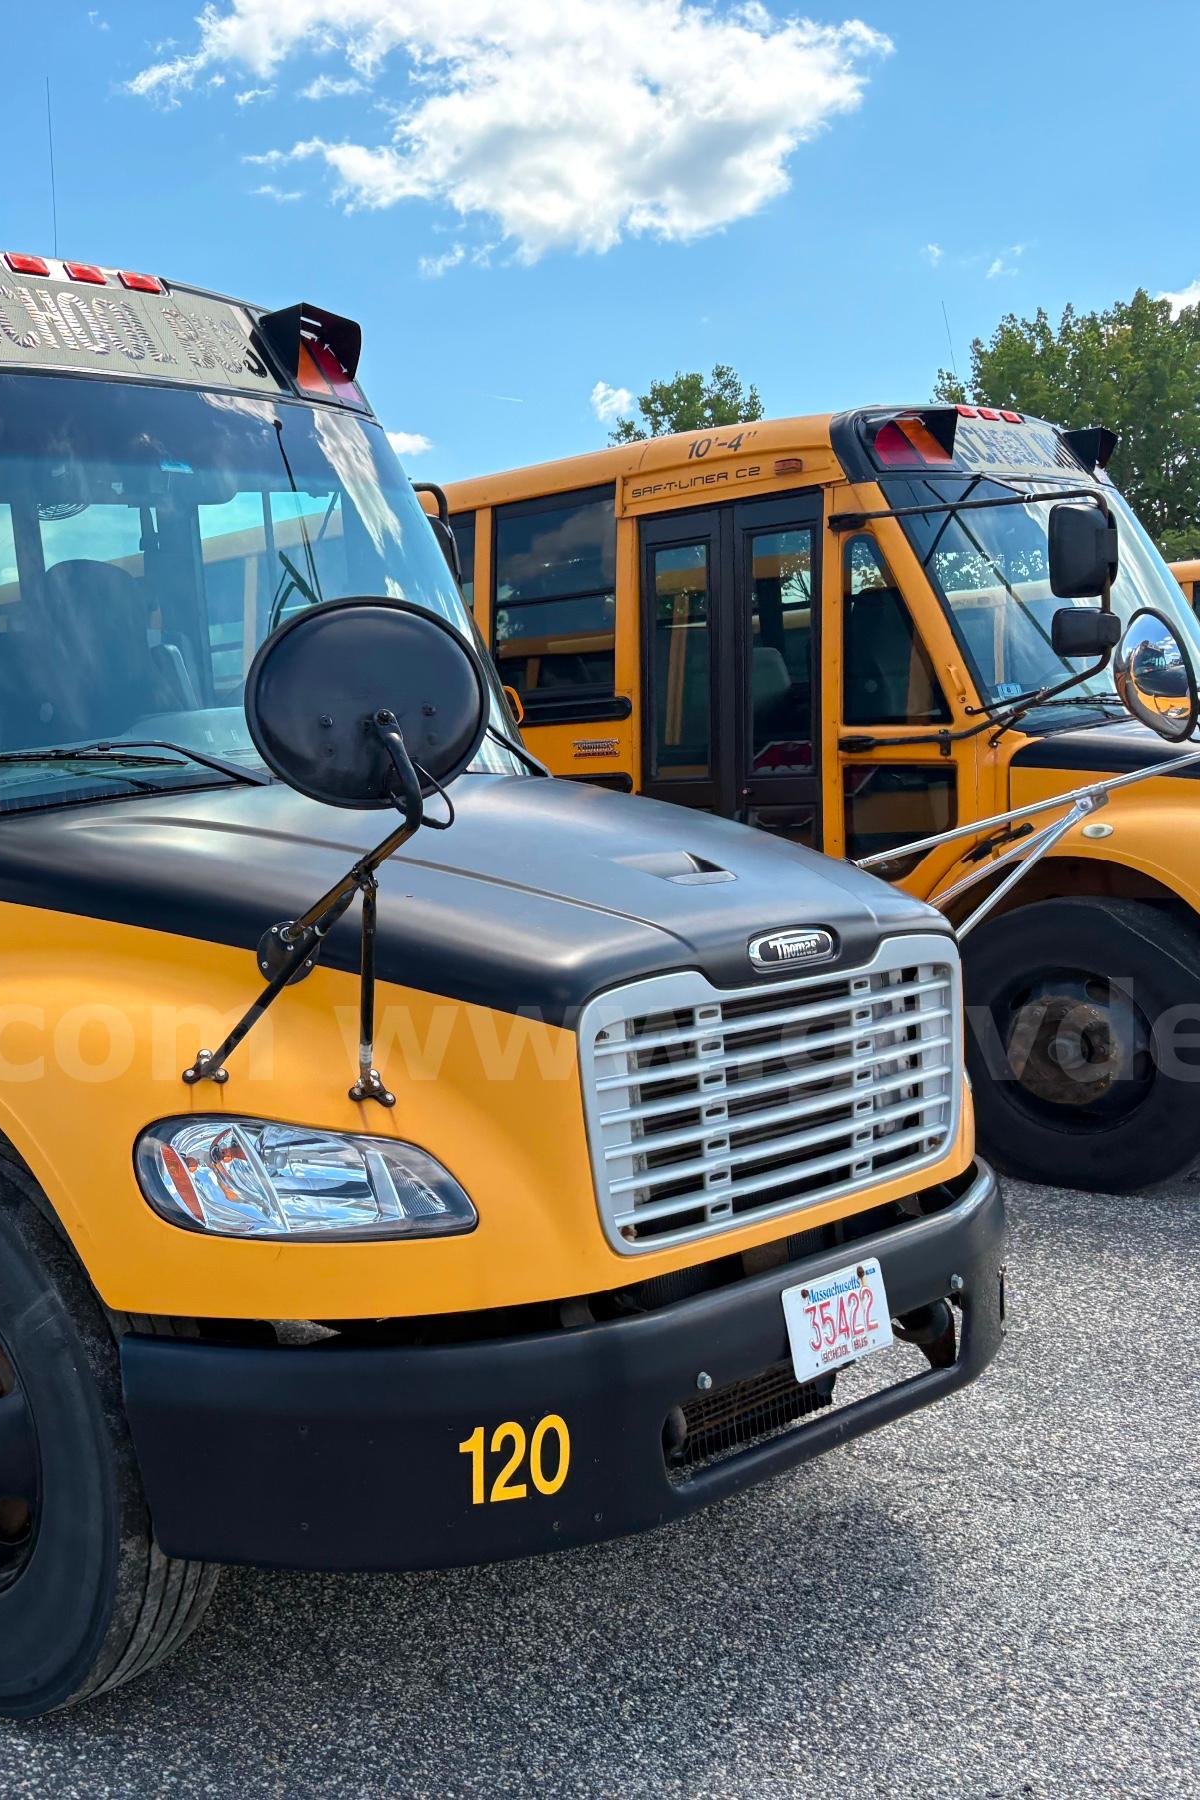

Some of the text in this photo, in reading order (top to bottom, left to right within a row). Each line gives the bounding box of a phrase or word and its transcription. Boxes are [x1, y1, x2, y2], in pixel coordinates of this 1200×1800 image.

[735, 465, 761, 479] C2
[768, 933, 821, 961] Thomas
[807, 1275, 861, 1305] Massachusetts
[804, 1287, 879, 1351] 35422
[821, 1335, 868, 1363] SCHOOL BUS
[458, 1413, 571, 1505] 120
